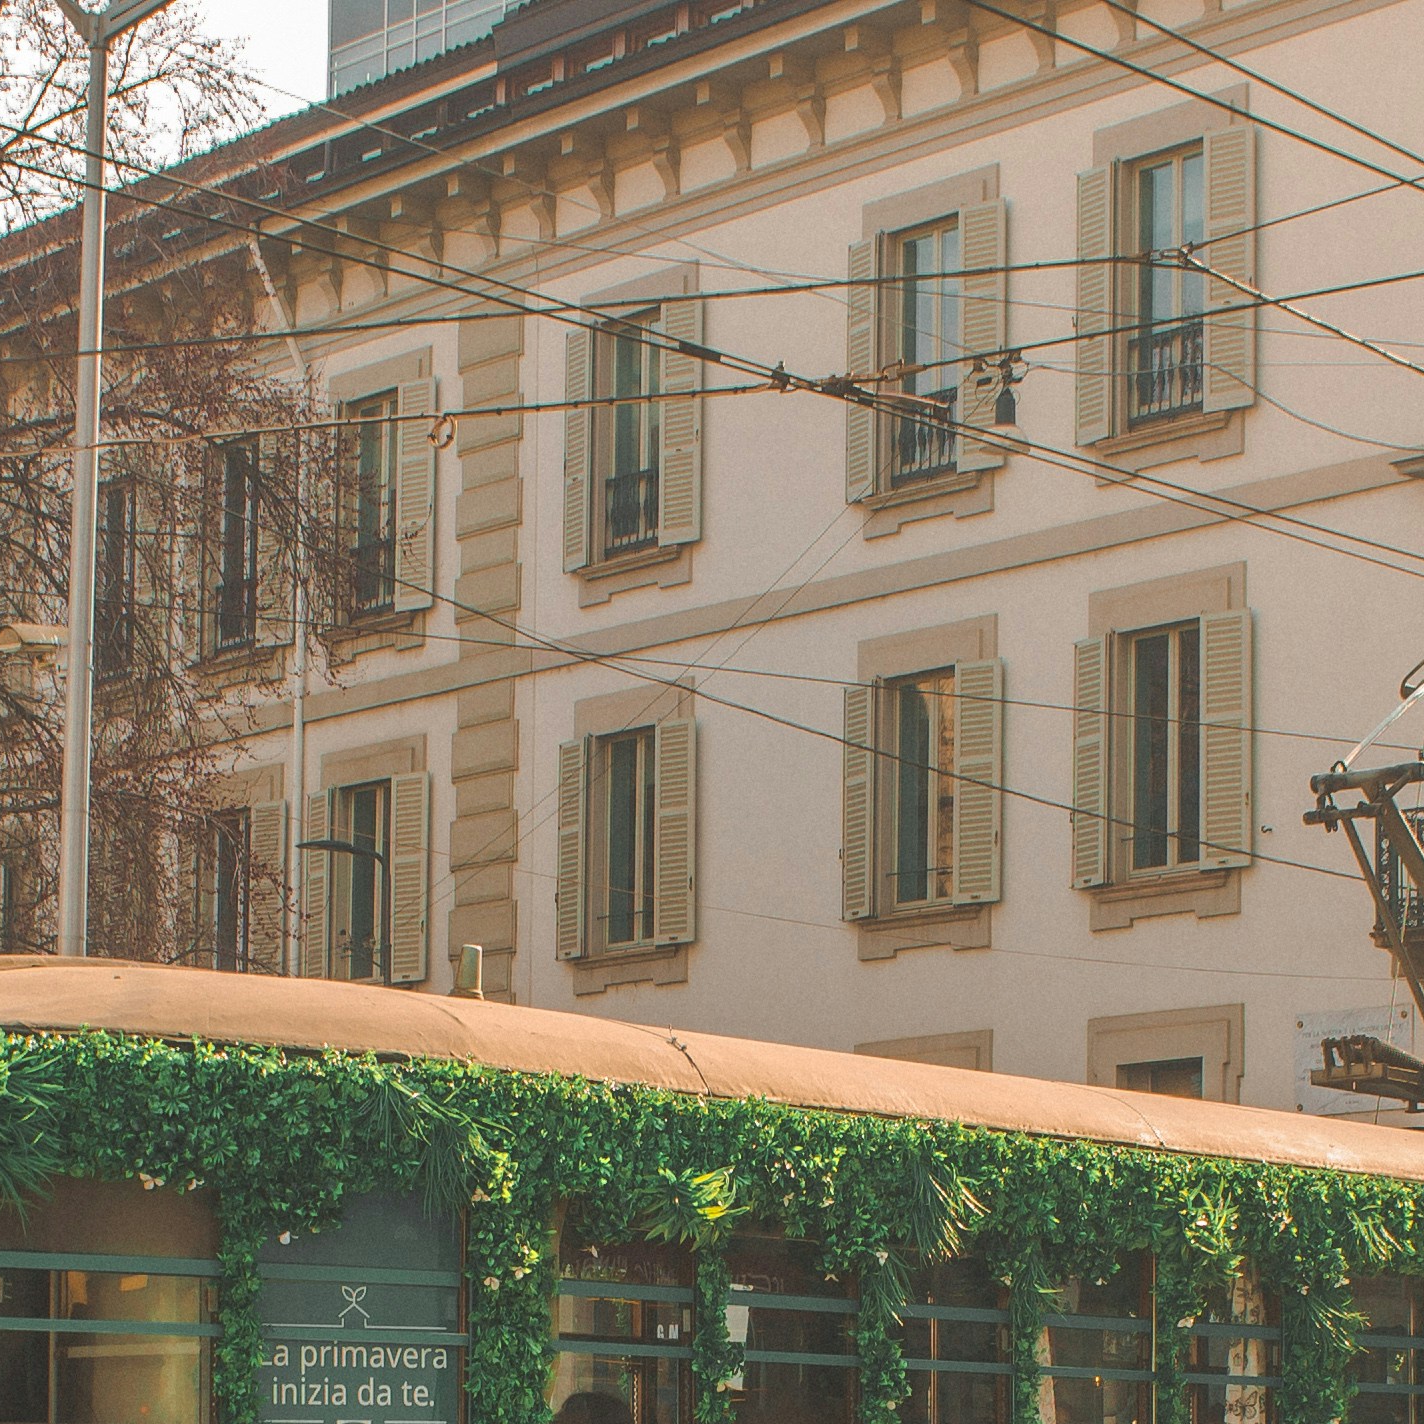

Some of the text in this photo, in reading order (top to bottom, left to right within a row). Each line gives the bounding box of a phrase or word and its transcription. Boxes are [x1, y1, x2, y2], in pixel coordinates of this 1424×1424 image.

[300, 1340, 448, 1375] primavera
[272, 1376, 436, 1408] inizia da te.
